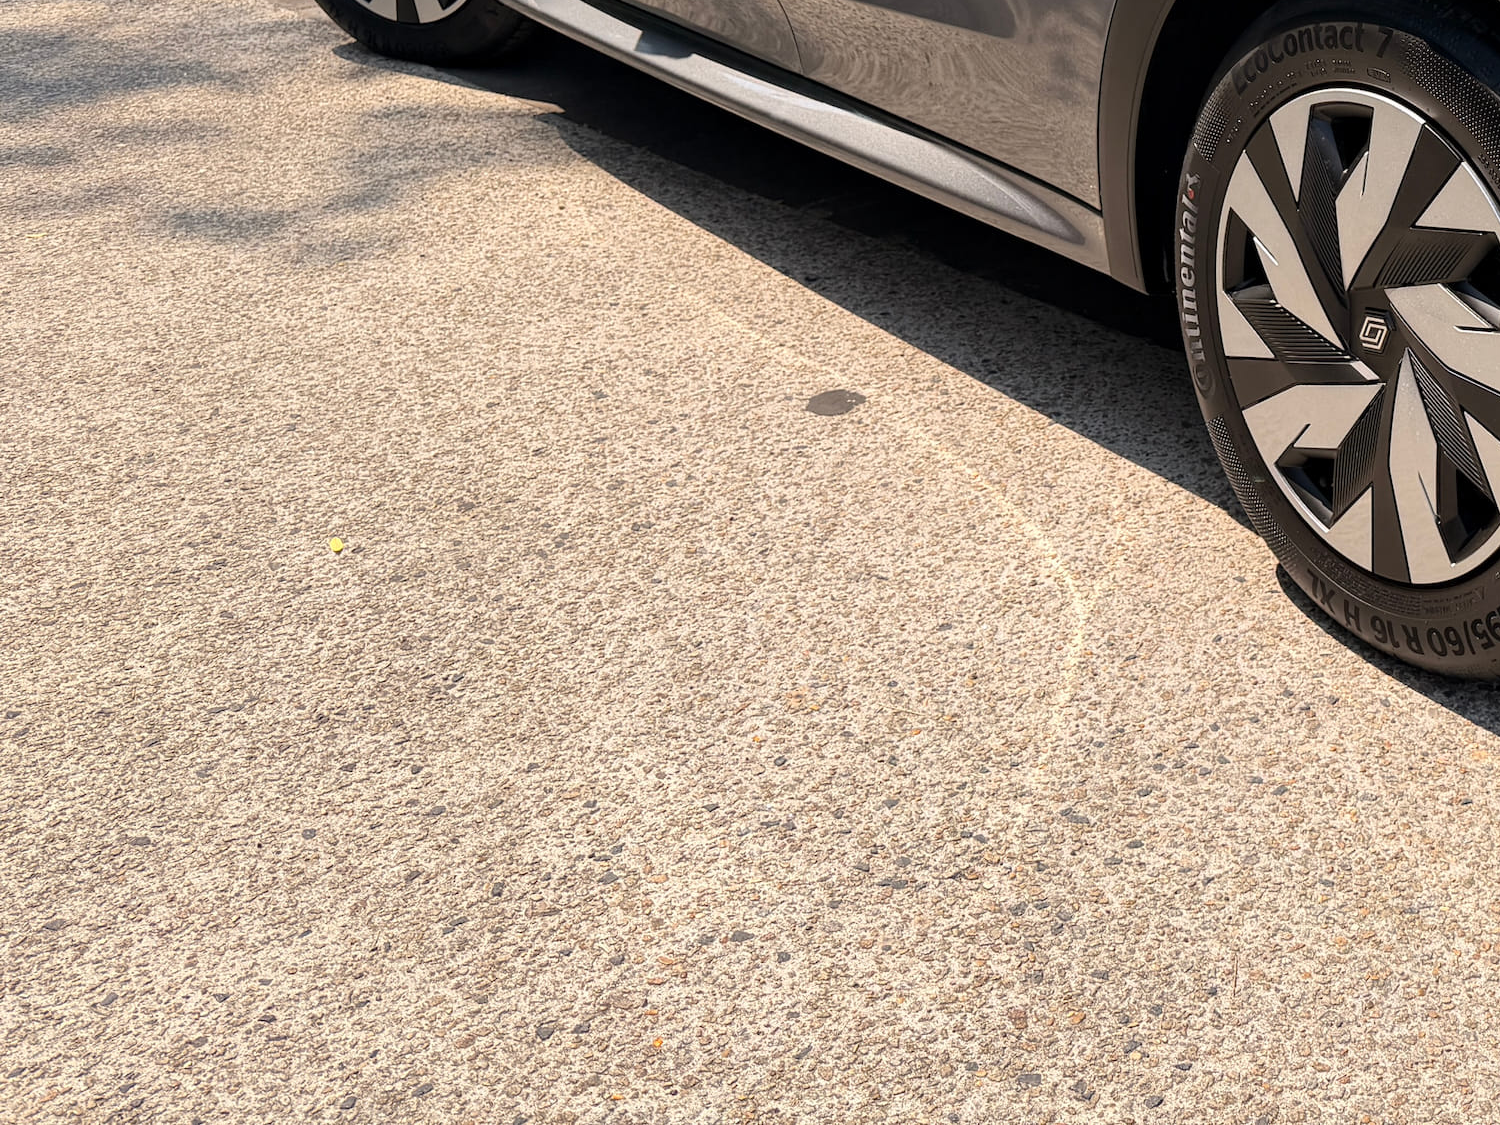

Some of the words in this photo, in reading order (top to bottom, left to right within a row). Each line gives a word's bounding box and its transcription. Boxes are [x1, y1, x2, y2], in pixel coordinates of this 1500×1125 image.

[1231, 21, 1366, 97] EcoContact
[1375, 25, 1394, 59] 7
[1306, 567, 1337, 614] XL
[1342, 598, 1363, 633] H
